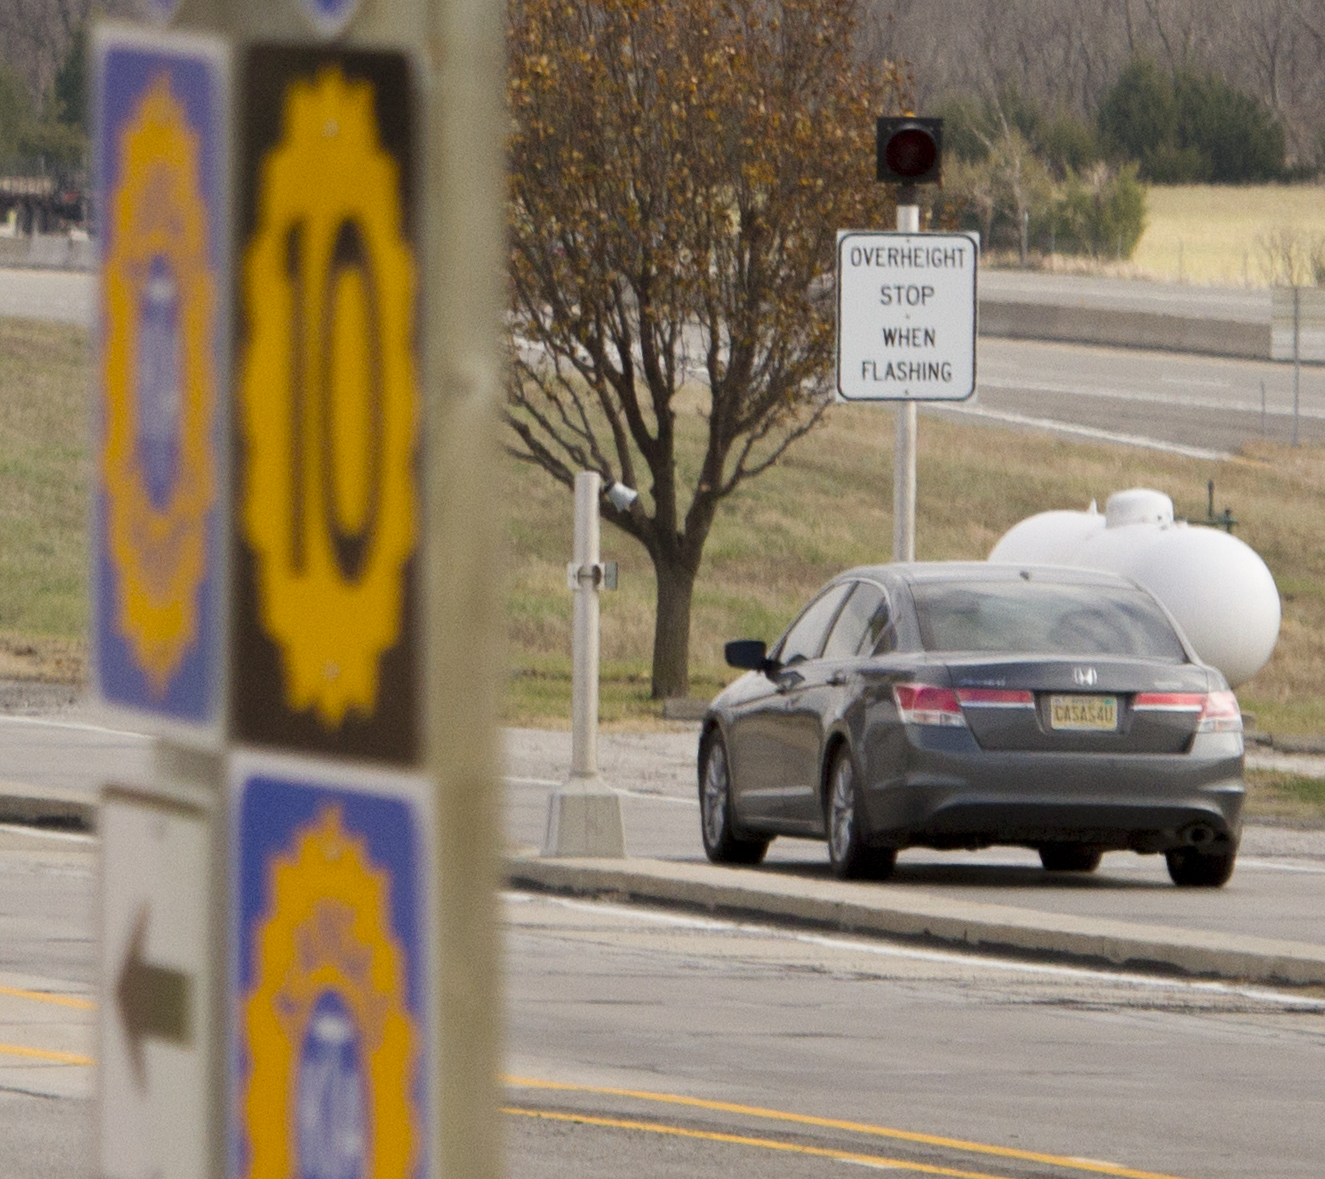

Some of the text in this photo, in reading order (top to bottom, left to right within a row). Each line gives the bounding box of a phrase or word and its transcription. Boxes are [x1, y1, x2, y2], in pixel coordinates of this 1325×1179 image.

[850, 247, 967, 269] OVERHEIGHT
[879, 284, 936, 307] STOP
[882, 328, 936, 348] WHEN
[861, 361, 954, 383] FLASHING
[281, 210, 381, 589] 10
